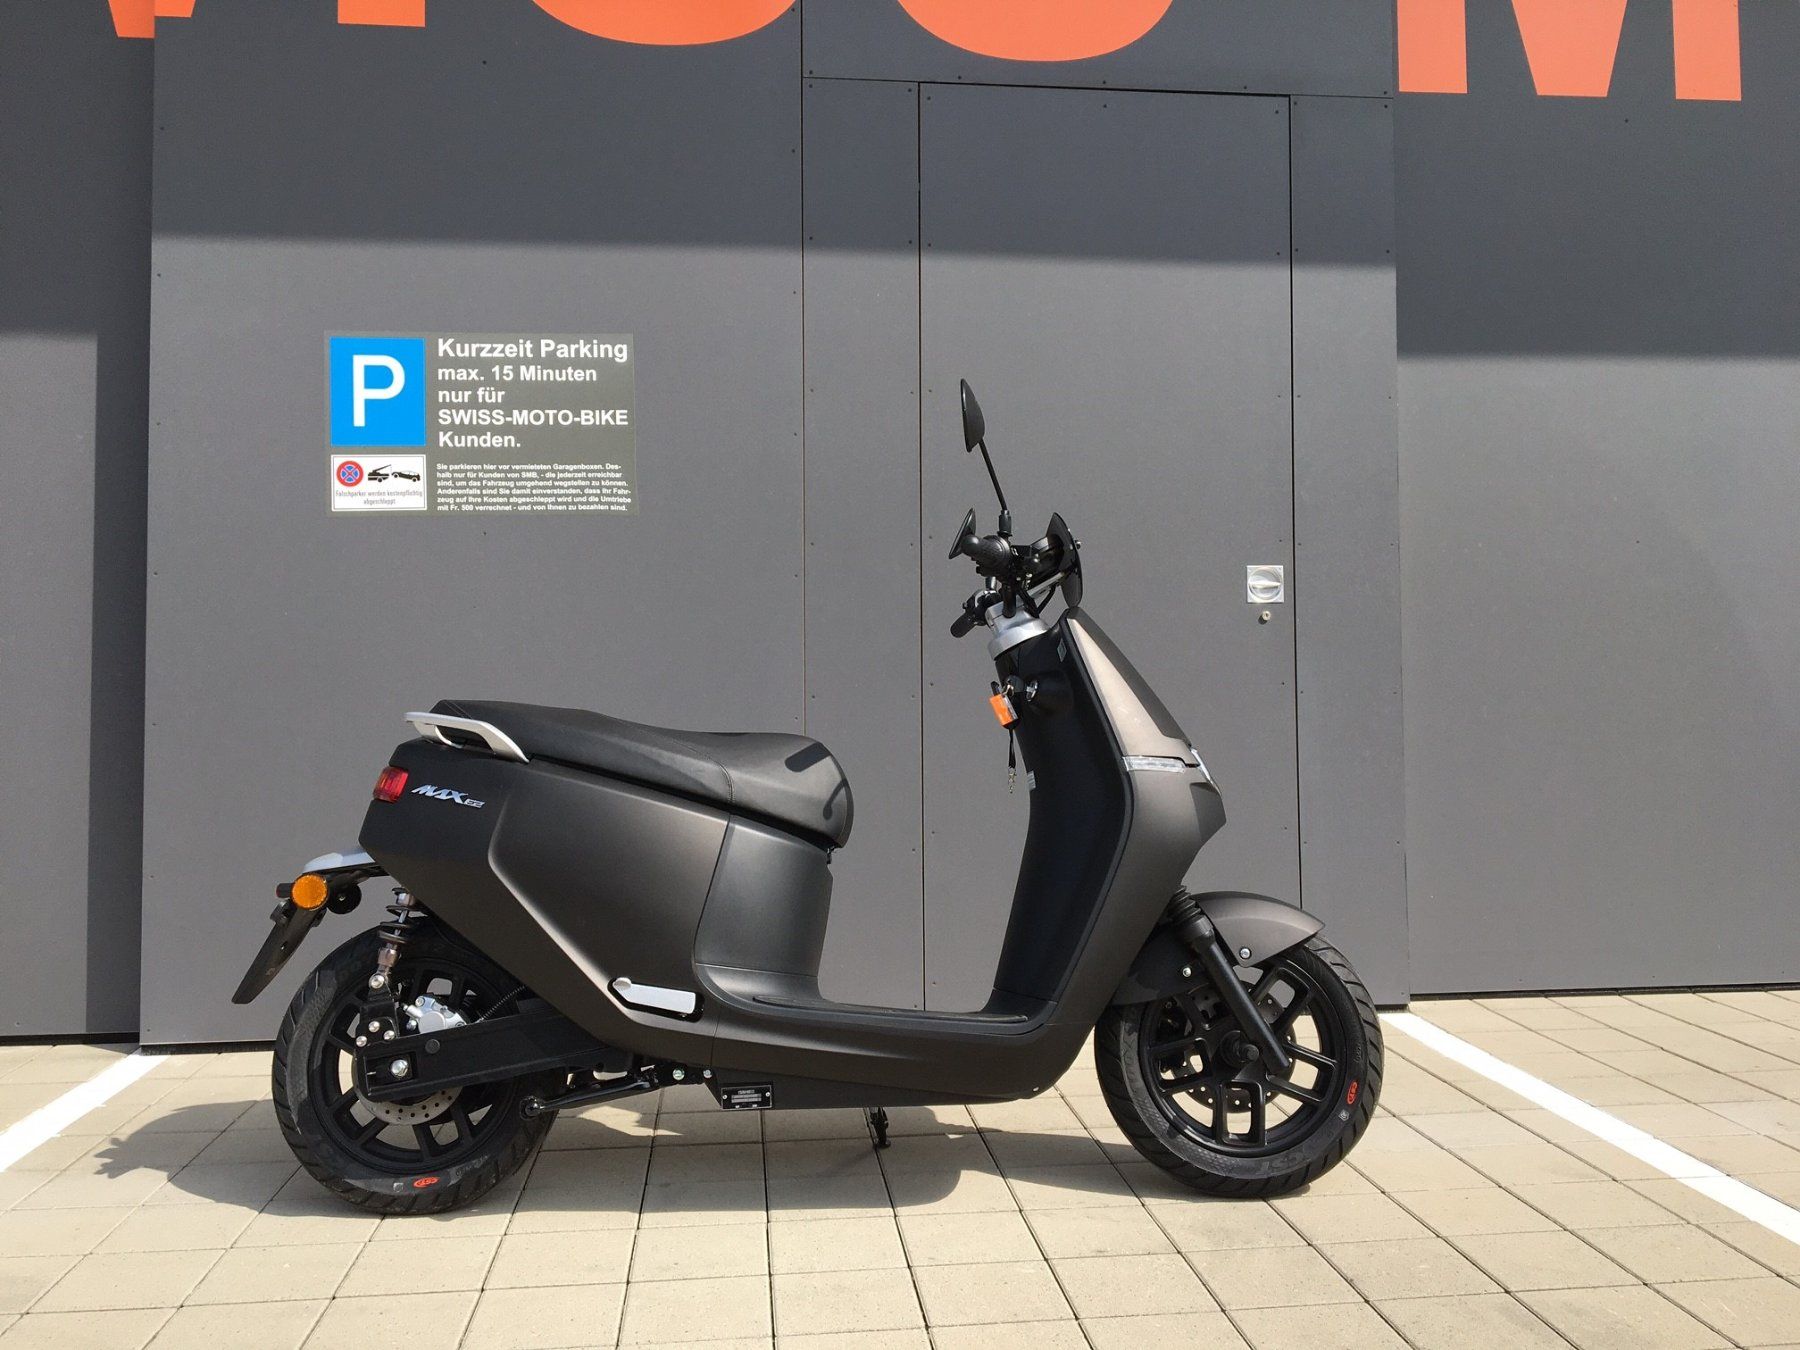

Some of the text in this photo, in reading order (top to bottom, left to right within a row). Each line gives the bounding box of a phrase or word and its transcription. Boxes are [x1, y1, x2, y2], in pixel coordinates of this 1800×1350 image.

[437, 339, 628, 362] Kurzzeit Parking
[438, 365, 597, 381] max. 15 Minuten
[353, 354, 405, 427] P
[438, 387, 505, 403] nur für
[438, 409, 628, 425] SWISS-MOTO-BIKE
[439, 431, 521, 447] Kunden.
[557, 471, 586, 479] jederzeit
[483, 480, 514, 488] Fahrzeug
[516, 480, 552, 488] umgehend
[554, 480, 590, 488] wegstellen
[437, 496, 454, 504] zeug
[509, 496, 556, 504] abgeschleppt
[411, 785, 468, 804] MAX
